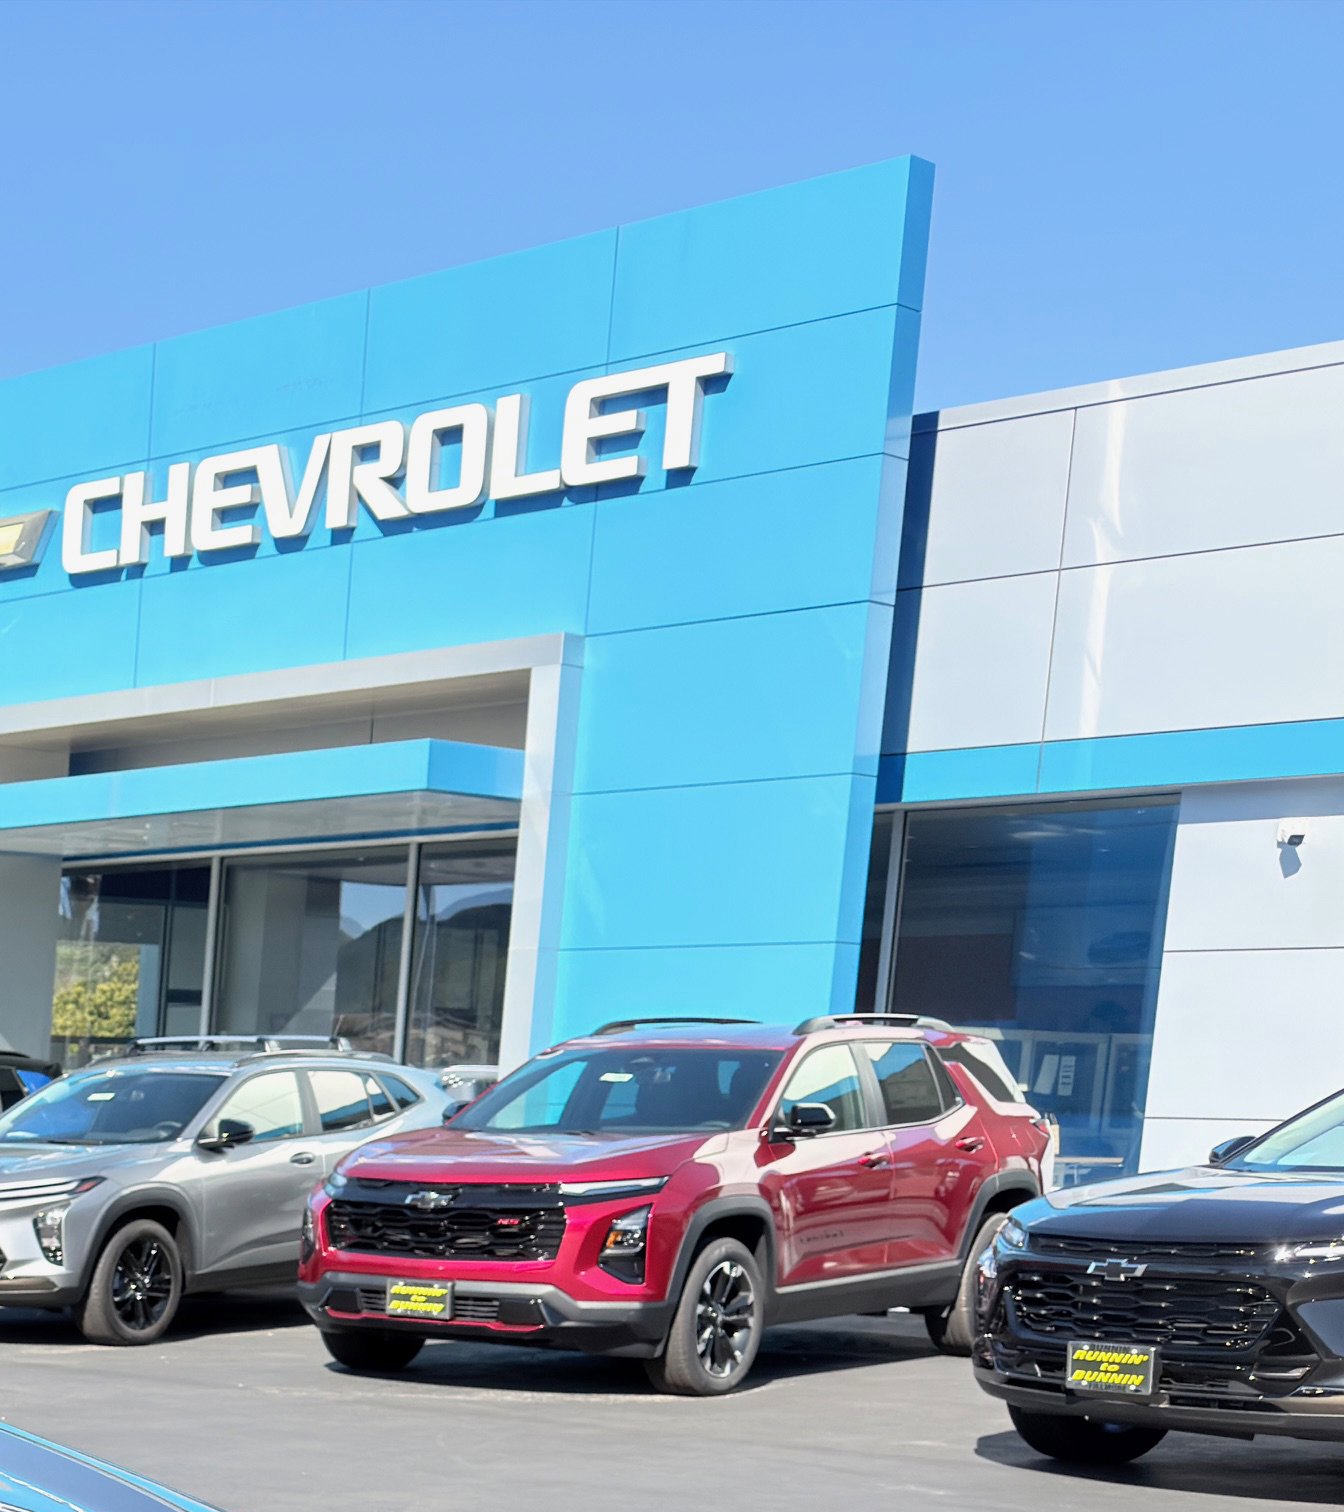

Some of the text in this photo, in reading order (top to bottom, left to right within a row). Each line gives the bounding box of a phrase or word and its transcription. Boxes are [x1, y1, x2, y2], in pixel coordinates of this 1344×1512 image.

[62, 352, 734, 574] CHEVROLET
[1072, 1350, 1149, 1365] RUNNIN'
[1099, 1363, 1120, 1372] to
[1072, 1369, 1145, 1386] BUNNIN
